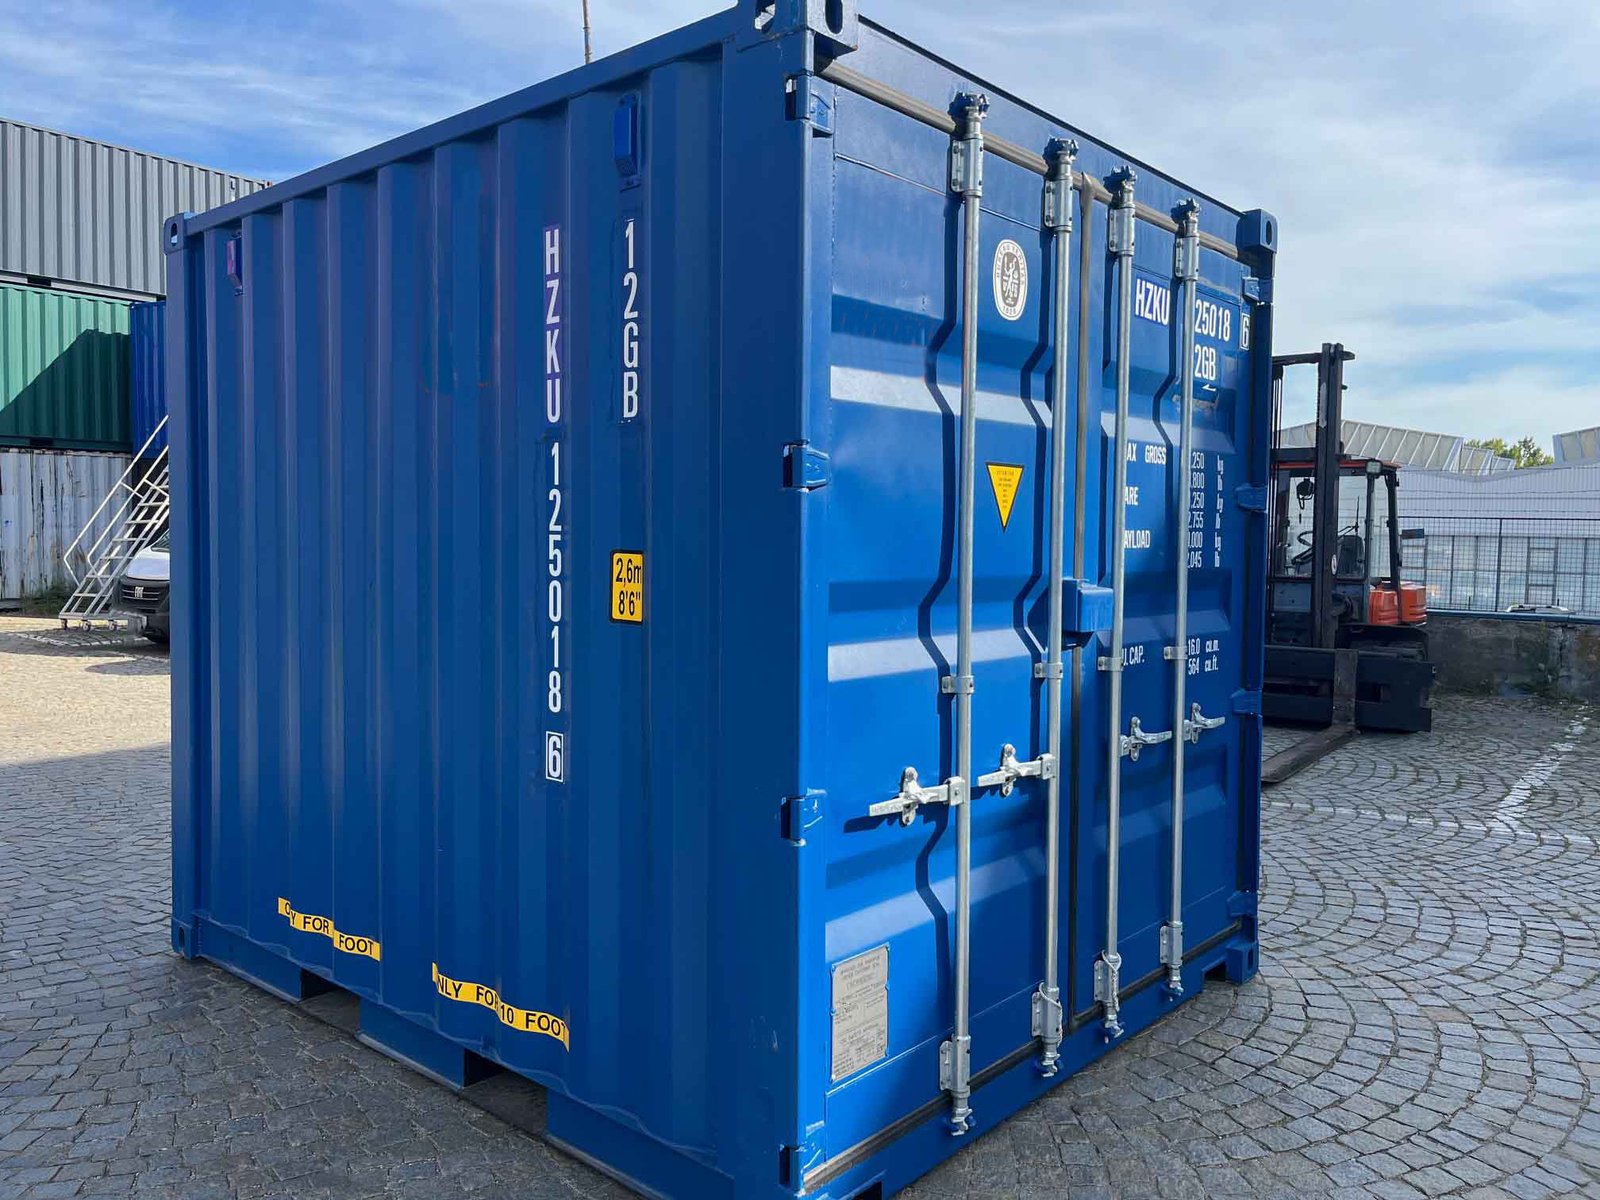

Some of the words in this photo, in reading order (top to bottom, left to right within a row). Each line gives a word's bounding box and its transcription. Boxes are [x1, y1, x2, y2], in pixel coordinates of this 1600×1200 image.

[545, 228, 561, 423] HZKU
[623, 221, 639, 418] 12GB
[1135, 278, 1171, 325] HZKU
[1194, 299, 1231, 342] 25018
[1242, 315, 1250, 349] 6
[1194, 344, 1216, 381] 2GB
[1126, 442, 1137, 462] AX
[1144, 445, 1167, 465] GROSS
[1124, 486, 1139, 506] ARE
[1123, 529, 1151, 549] AYLOAD
[548, 441, 562, 713] 125018
[1129, 645, 1145, 665] CAP.
[1187, 638, 1201, 656] 16.0
[1187, 658, 1200, 676] 564
[548, 734, 562, 778] 6
[302, 916, 330, 935] FOR
[339, 933, 374, 956] FOOT
[438, 975, 463, 999] NLY
[500, 1004, 514, 1025] 10
